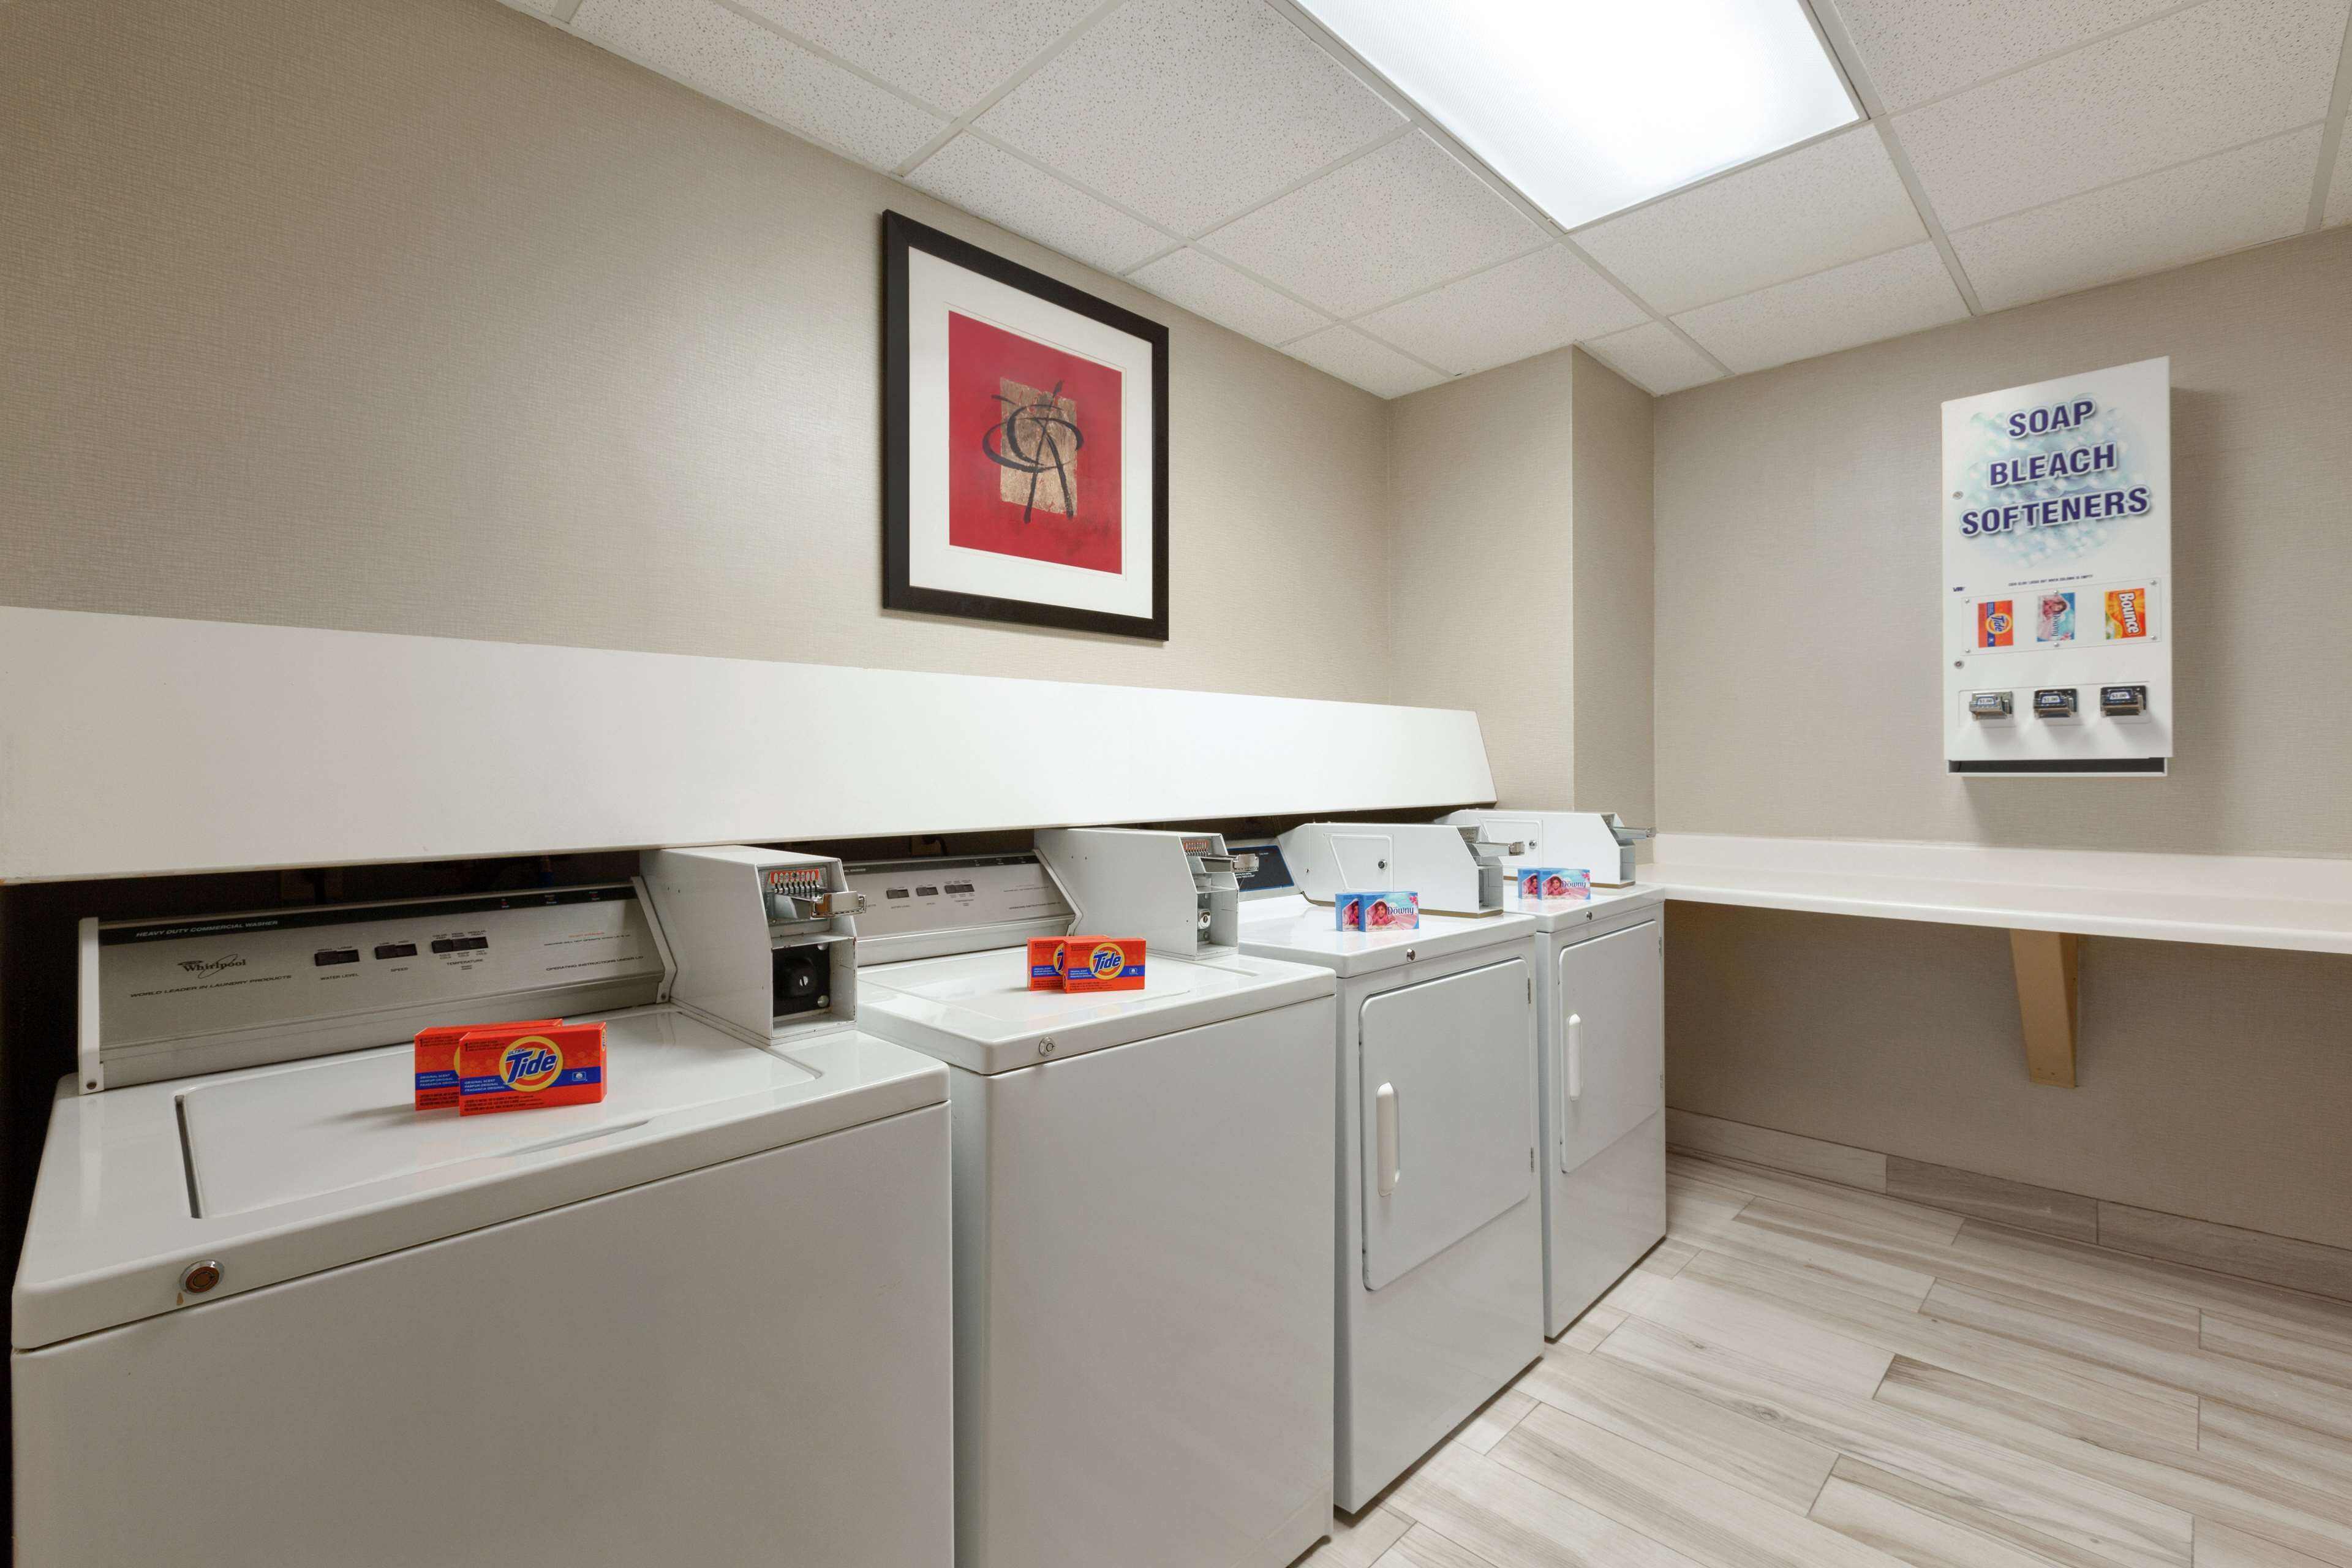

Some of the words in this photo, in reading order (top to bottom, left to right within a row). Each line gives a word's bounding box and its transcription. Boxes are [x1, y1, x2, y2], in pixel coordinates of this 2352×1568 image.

[2008, 400, 2094, 437] SOAP
[1990, 443, 2114, 486] BLEACH
[1962, 488, 2148, 535] SOFTENERS
[1991, 615, 2005, 632] Tide
[2051, 612, 2061, 636] Downy
[2119, 592, 2140, 633] Bounce
[1387, 906, 1414, 916] Downy
[190, 923, 244, 932] COMMERCIAL
[178, 957, 247, 974] Whirlpool
[1092, 951, 1122, 975] Tide
[164, 985, 197, 993] LEADER
[209, 979, 247, 988] LAUNDRY
[249, 974, 292, 983] PRODUCTS
[505, 1048, 558, 1085] Tide
